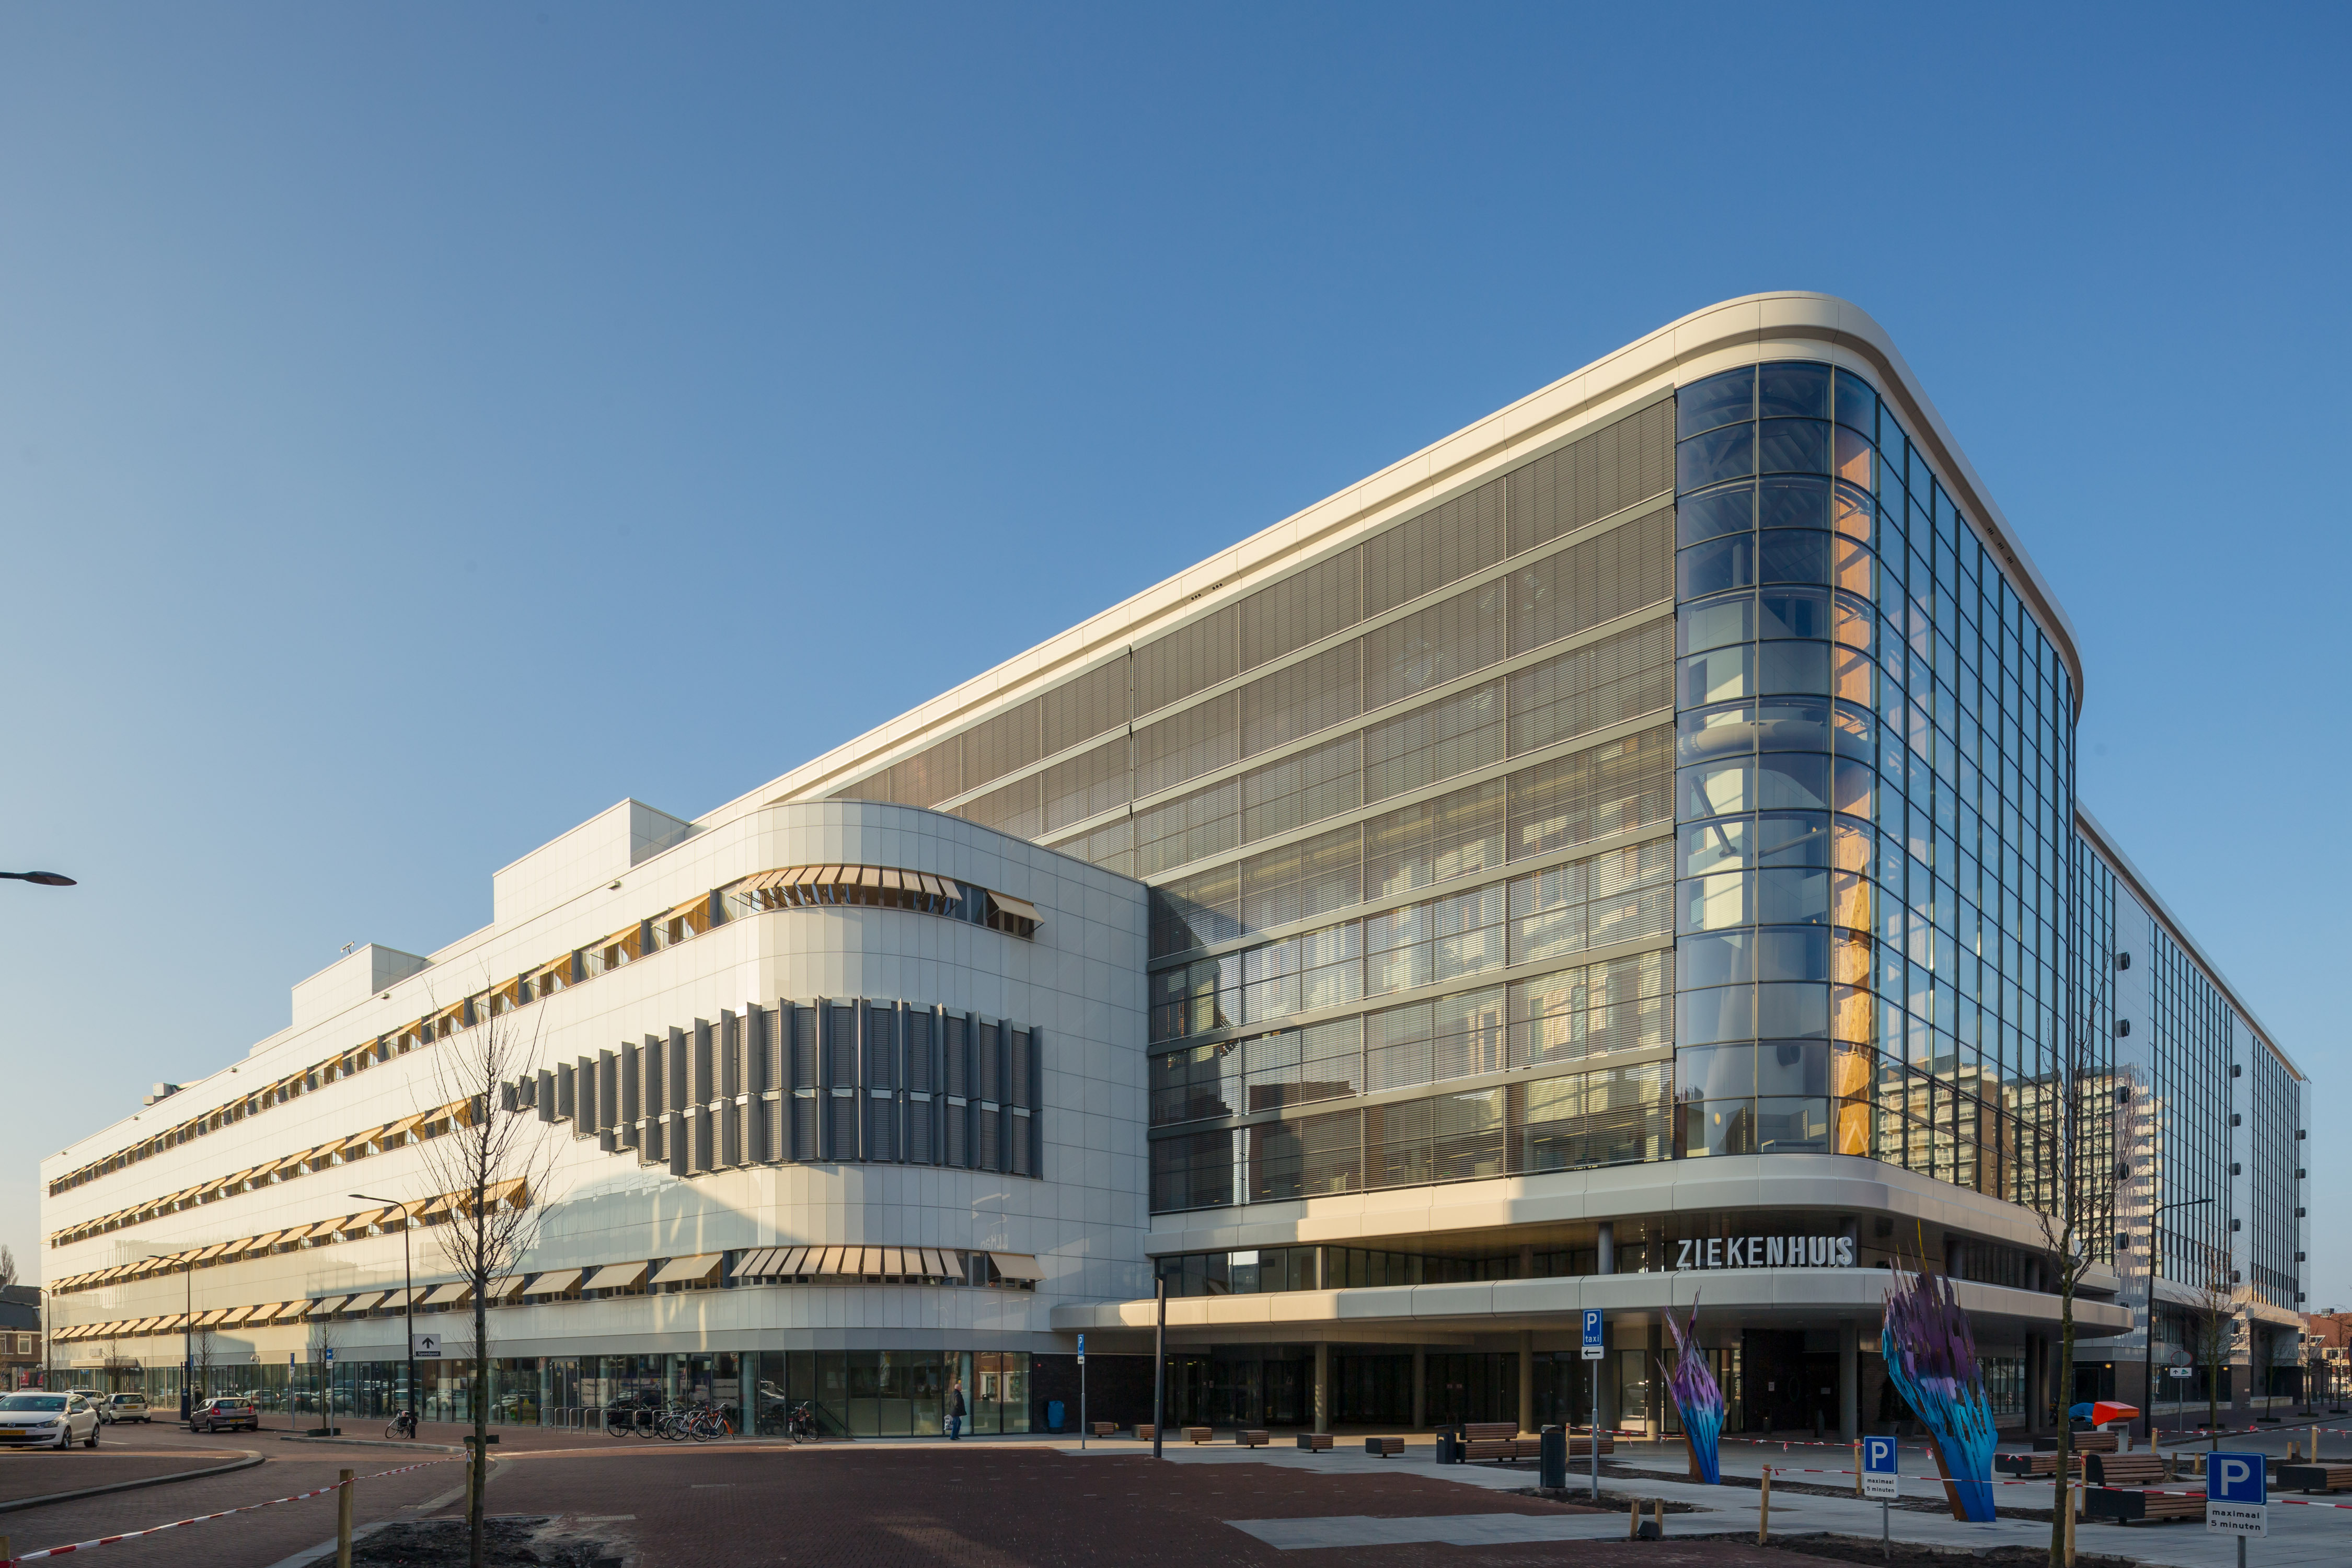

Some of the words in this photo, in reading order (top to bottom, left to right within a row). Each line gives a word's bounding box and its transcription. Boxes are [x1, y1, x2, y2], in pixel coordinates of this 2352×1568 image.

[1676, 1236, 1853, 1267] ZIEKENHUIS
[1587, 1312, 1597, 1331] P
[1079, 1336, 1082, 1347] P
[1585, 1334, 1599, 1343] taxi
[1871, 1442, 1888, 1469] P
[2221, 1459, 2250, 1496] P
[2212, 1510, 2260, 1519] maximaal
[2220, 1521, 2261, 1530] minuten
